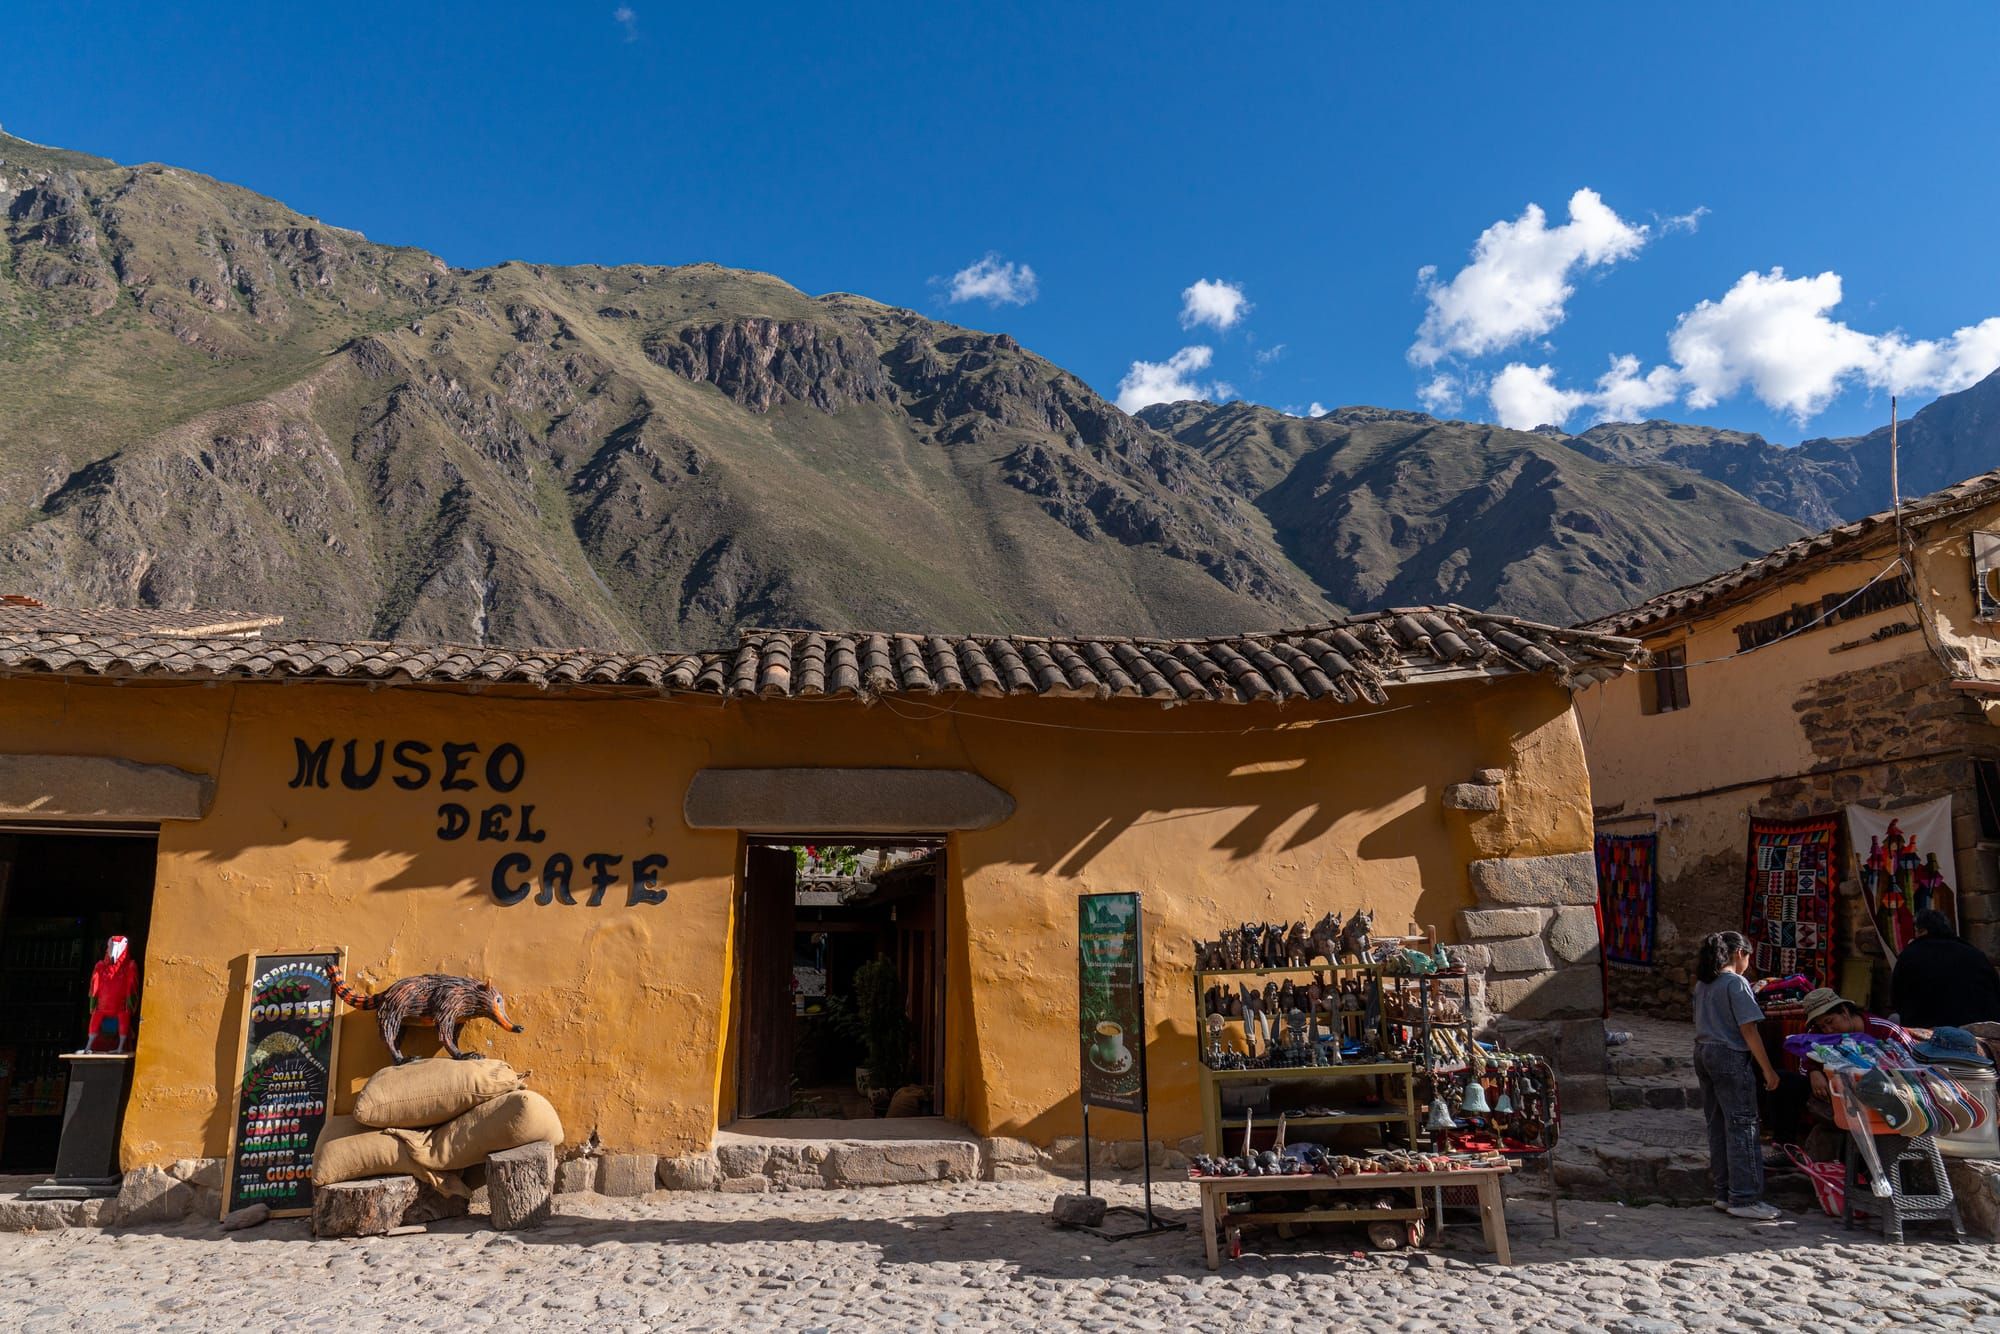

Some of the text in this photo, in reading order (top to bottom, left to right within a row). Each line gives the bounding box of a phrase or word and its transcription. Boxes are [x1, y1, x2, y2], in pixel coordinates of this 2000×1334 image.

[288, 737, 526, 793] MUSEO
[436, 803, 547, 843] DEL
[490, 852, 670, 907] CAFE
[251, 1000, 333, 1023] COFFEE
[268, 1081, 307, 1092] COFFEE
[247, 1100, 324, 1120] SELECTED
[245, 1118, 301, 1136] GRAINS
[240, 1149, 295, 1168] COFFEE
[239, 1164, 313, 1184] THE CUSCO
[239, 1181, 298, 1199] JUNGLE
